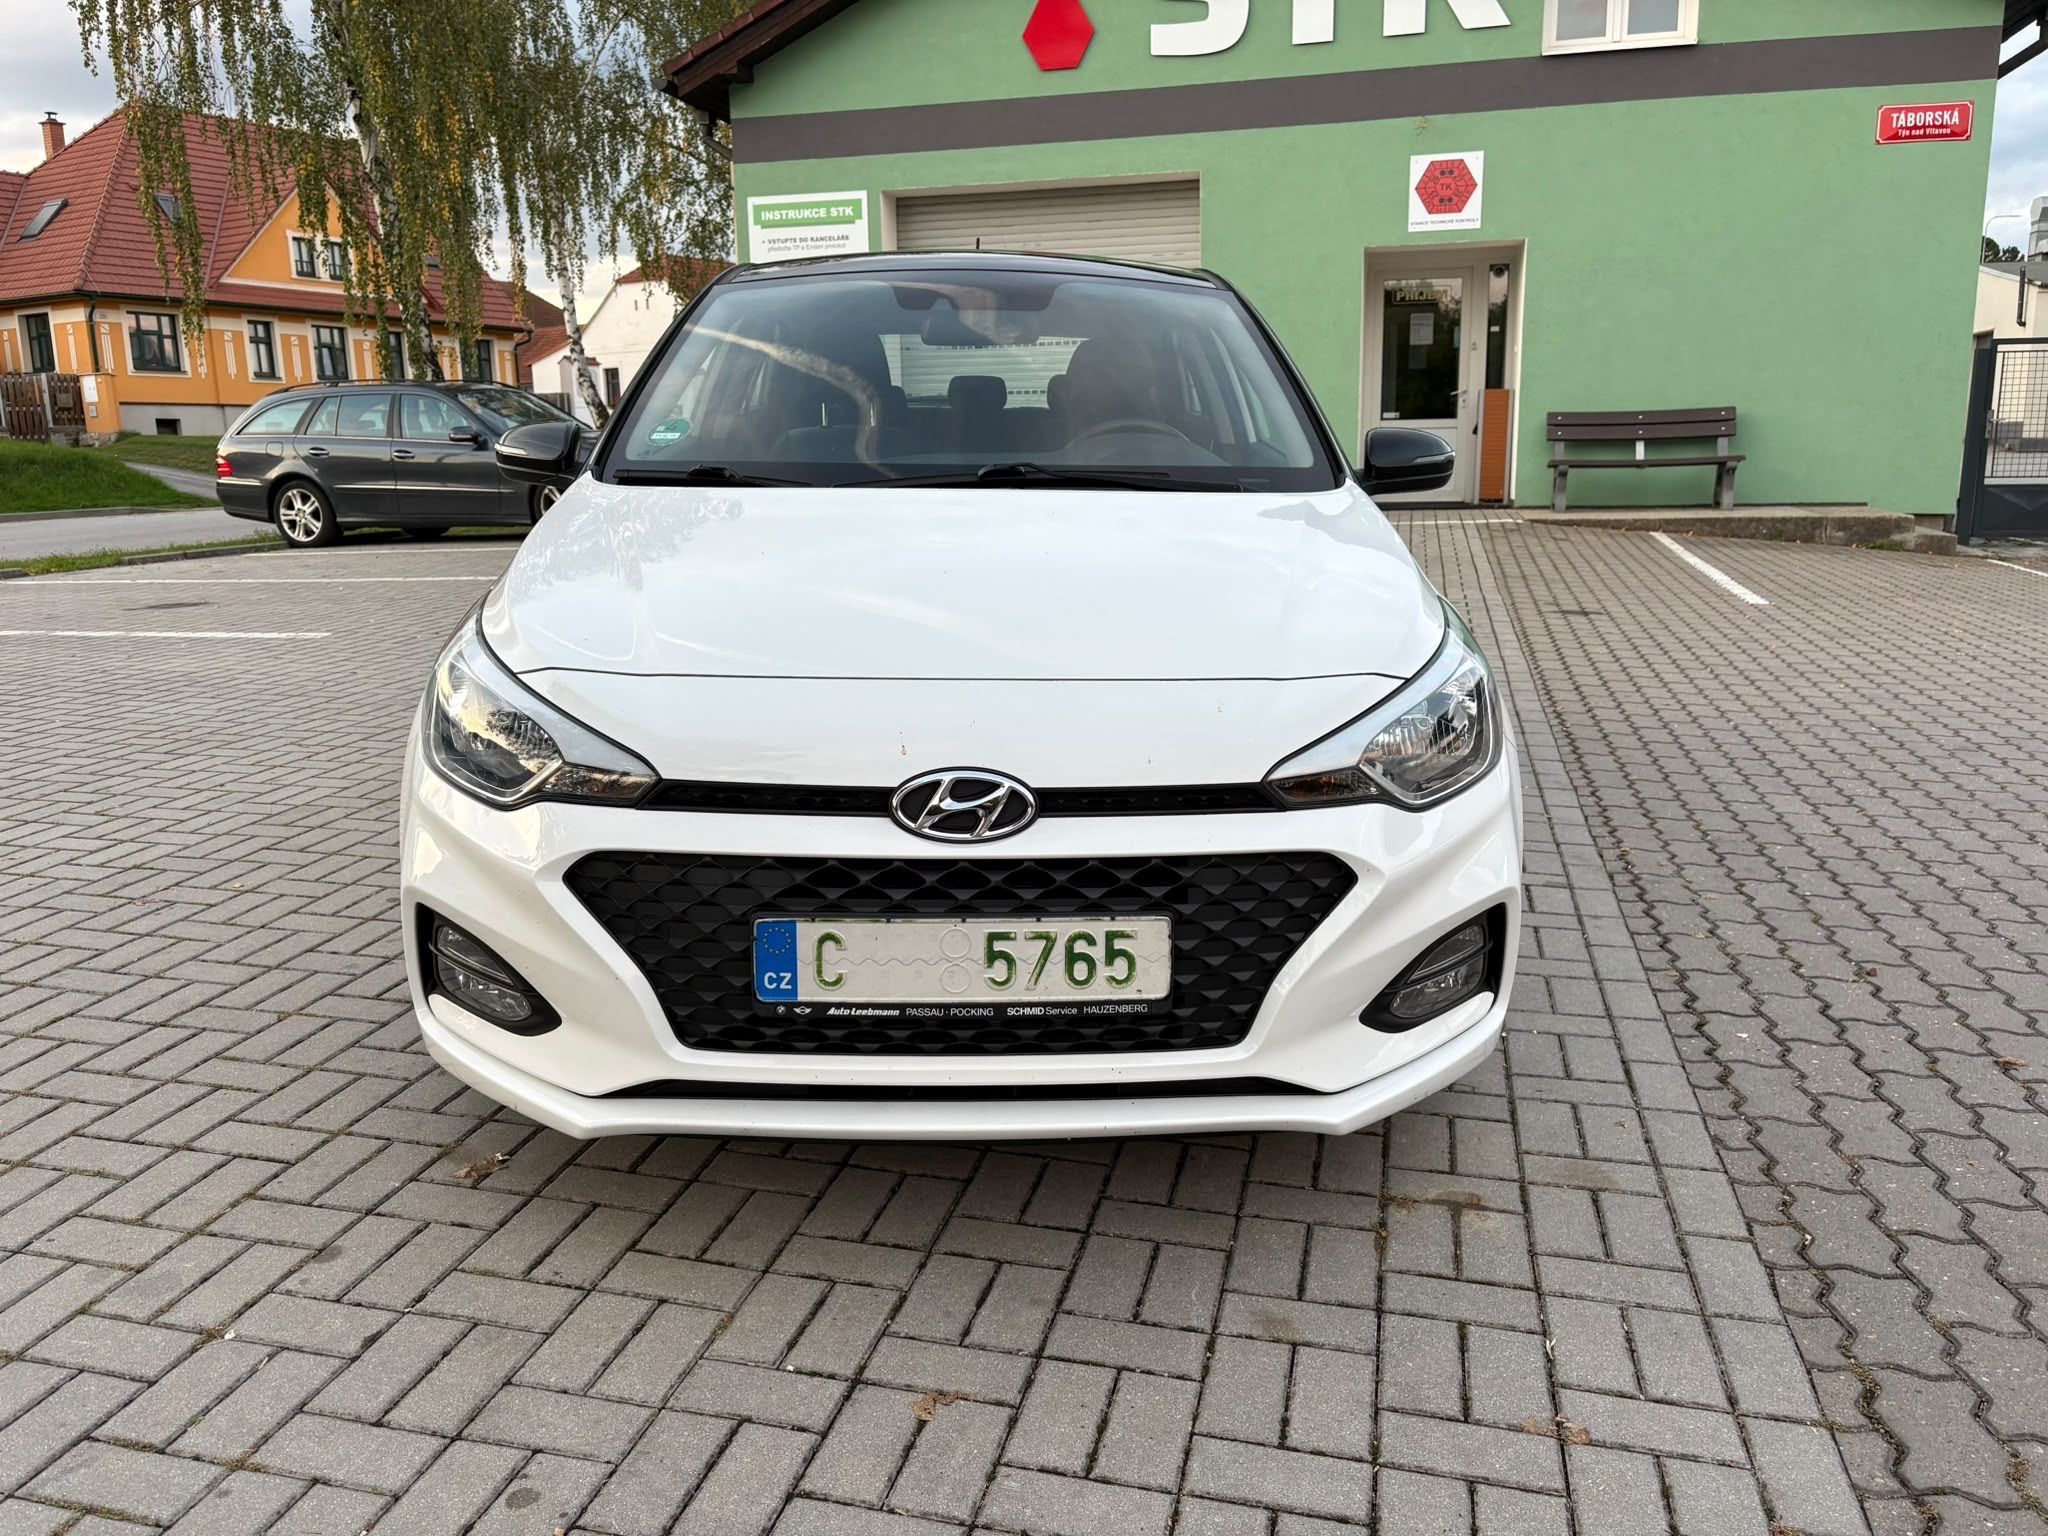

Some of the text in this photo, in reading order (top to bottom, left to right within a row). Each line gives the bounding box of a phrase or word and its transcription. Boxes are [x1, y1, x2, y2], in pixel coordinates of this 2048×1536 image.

[1891, 108, 1959, 128] TÁBORSKÁ
[1898, 127, 1951, 137] Týn nad Vltavou
[761, 206, 854, 221] INSTRUKCE STK
[768, 237, 797, 245] VSTUPTE
[814, 929, 1138, 991] C 5765
[763, 971, 792, 989] CZ
[827, 1004, 1148, 1016] Auto Leebmann PASSAU POCKING SCHMID Service HAUZENBERG
